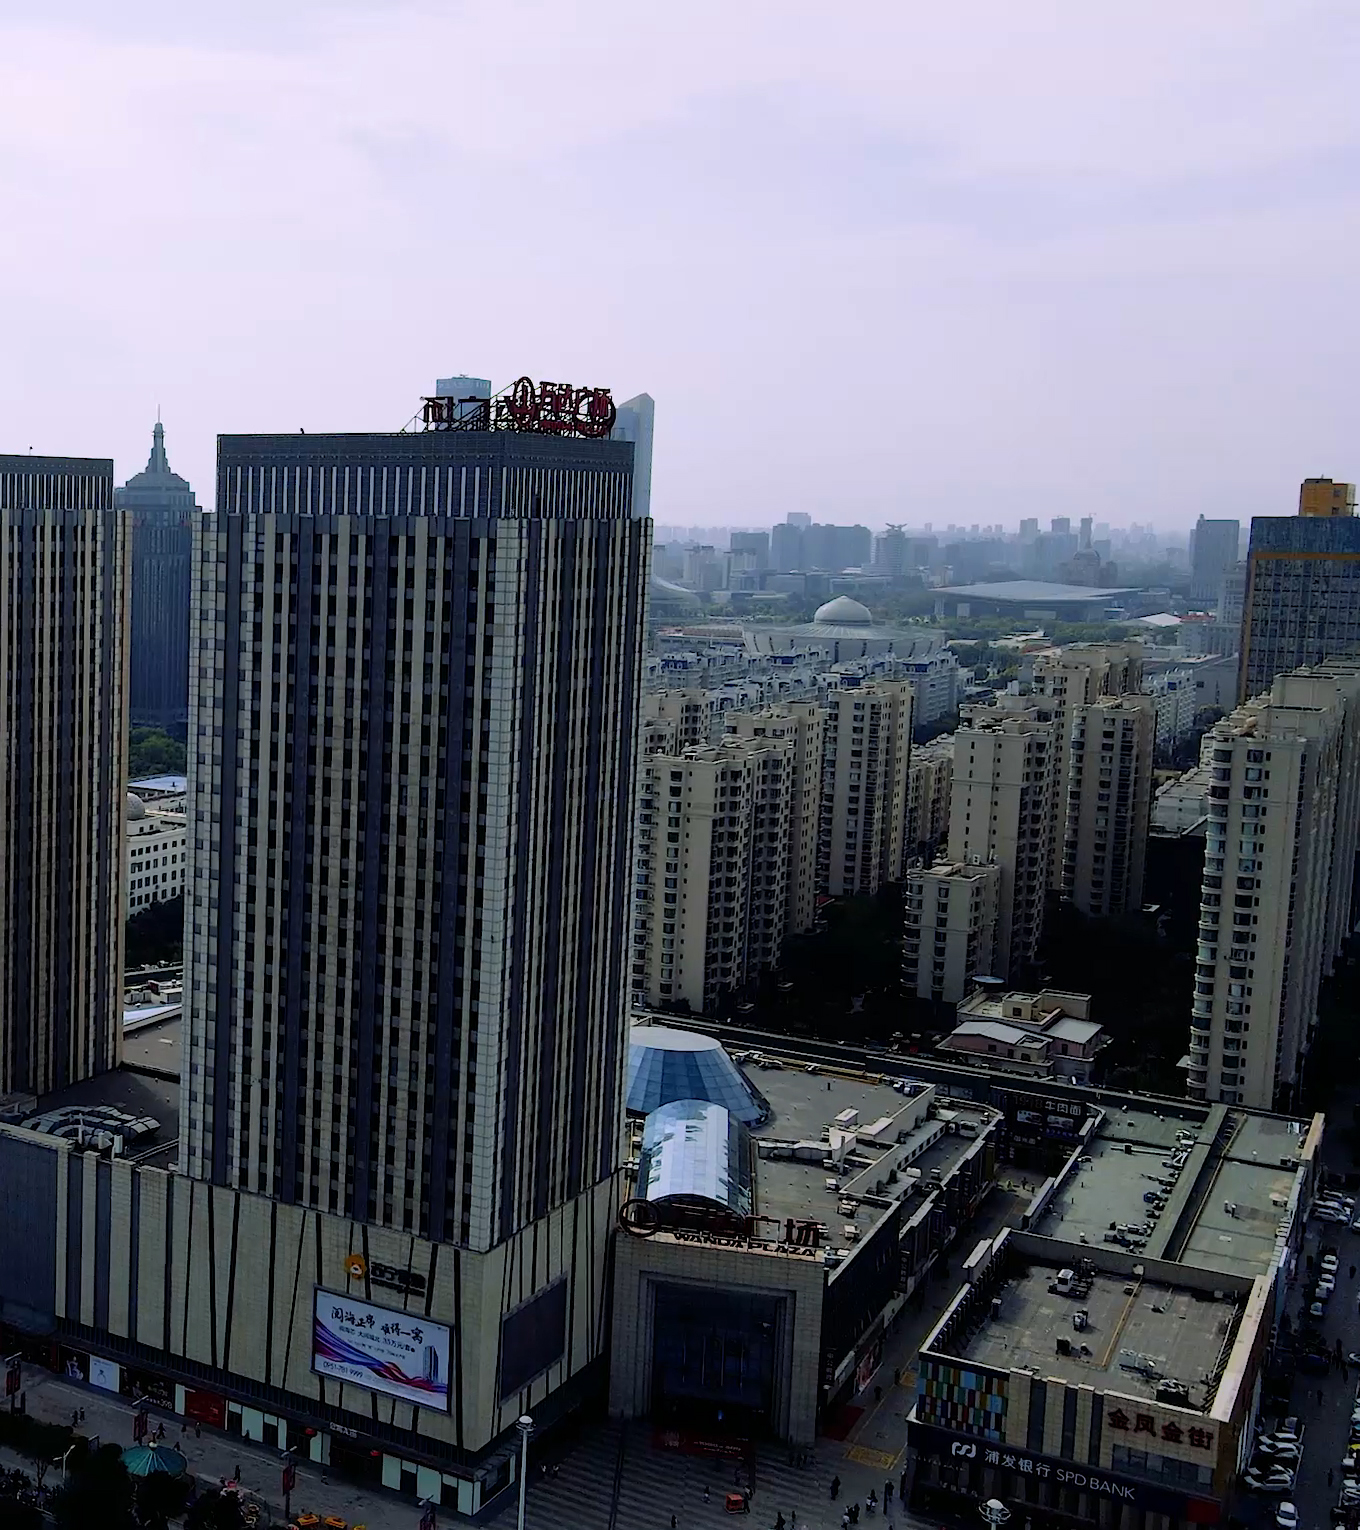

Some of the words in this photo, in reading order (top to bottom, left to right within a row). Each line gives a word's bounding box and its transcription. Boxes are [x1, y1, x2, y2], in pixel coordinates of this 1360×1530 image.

[673, 1232, 744, 1249] WANDA
[747, 1240, 816, 1257] PLAZA
[1108, 1407, 1214, 1450] 金凤金街
[984, 1447, 1051, 1478] 浦发银行
[1056, 1468, 1087, 1486] SPD
[1090, 1477, 1136, 1501] BANK
